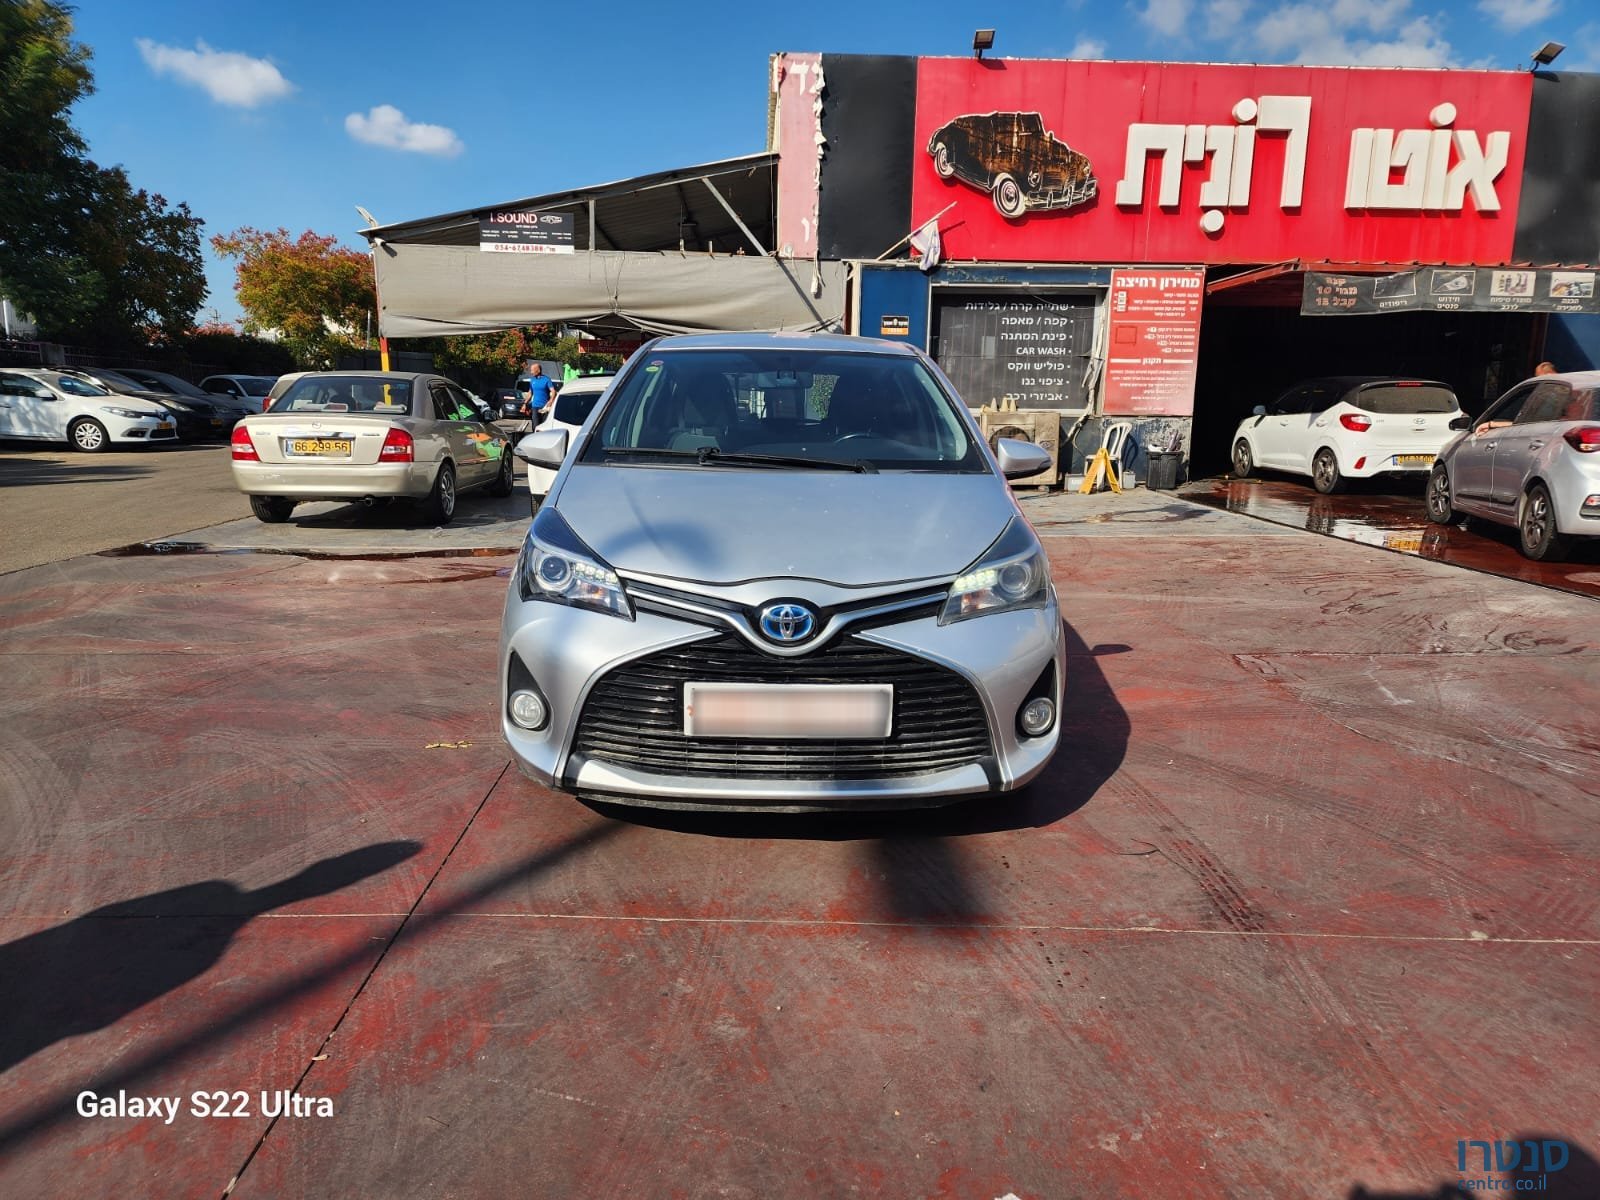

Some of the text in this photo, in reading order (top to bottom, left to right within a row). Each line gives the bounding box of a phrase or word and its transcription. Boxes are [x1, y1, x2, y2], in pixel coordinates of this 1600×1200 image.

[1116, 276, 1200, 290] מחירון רחיצה
[965, 301, 1000, 311] גלידות
[1010, 303, 1032, 312] קרה
[1037, 303, 1069, 311] שתייה
[1001, 317, 1034, 325] מאפה
[1044, 318, 1068, 327] קפה
[1000, 332, 1067, 341] פינת המתנה
[1016, 347, 1066, 355] CAR WASH
[1007, 361, 1065, 372] פוליש ווקס
[1021, 378, 1064, 386] ציפוי ננו
[1006, 392, 1063, 401] אביזרי רכב
